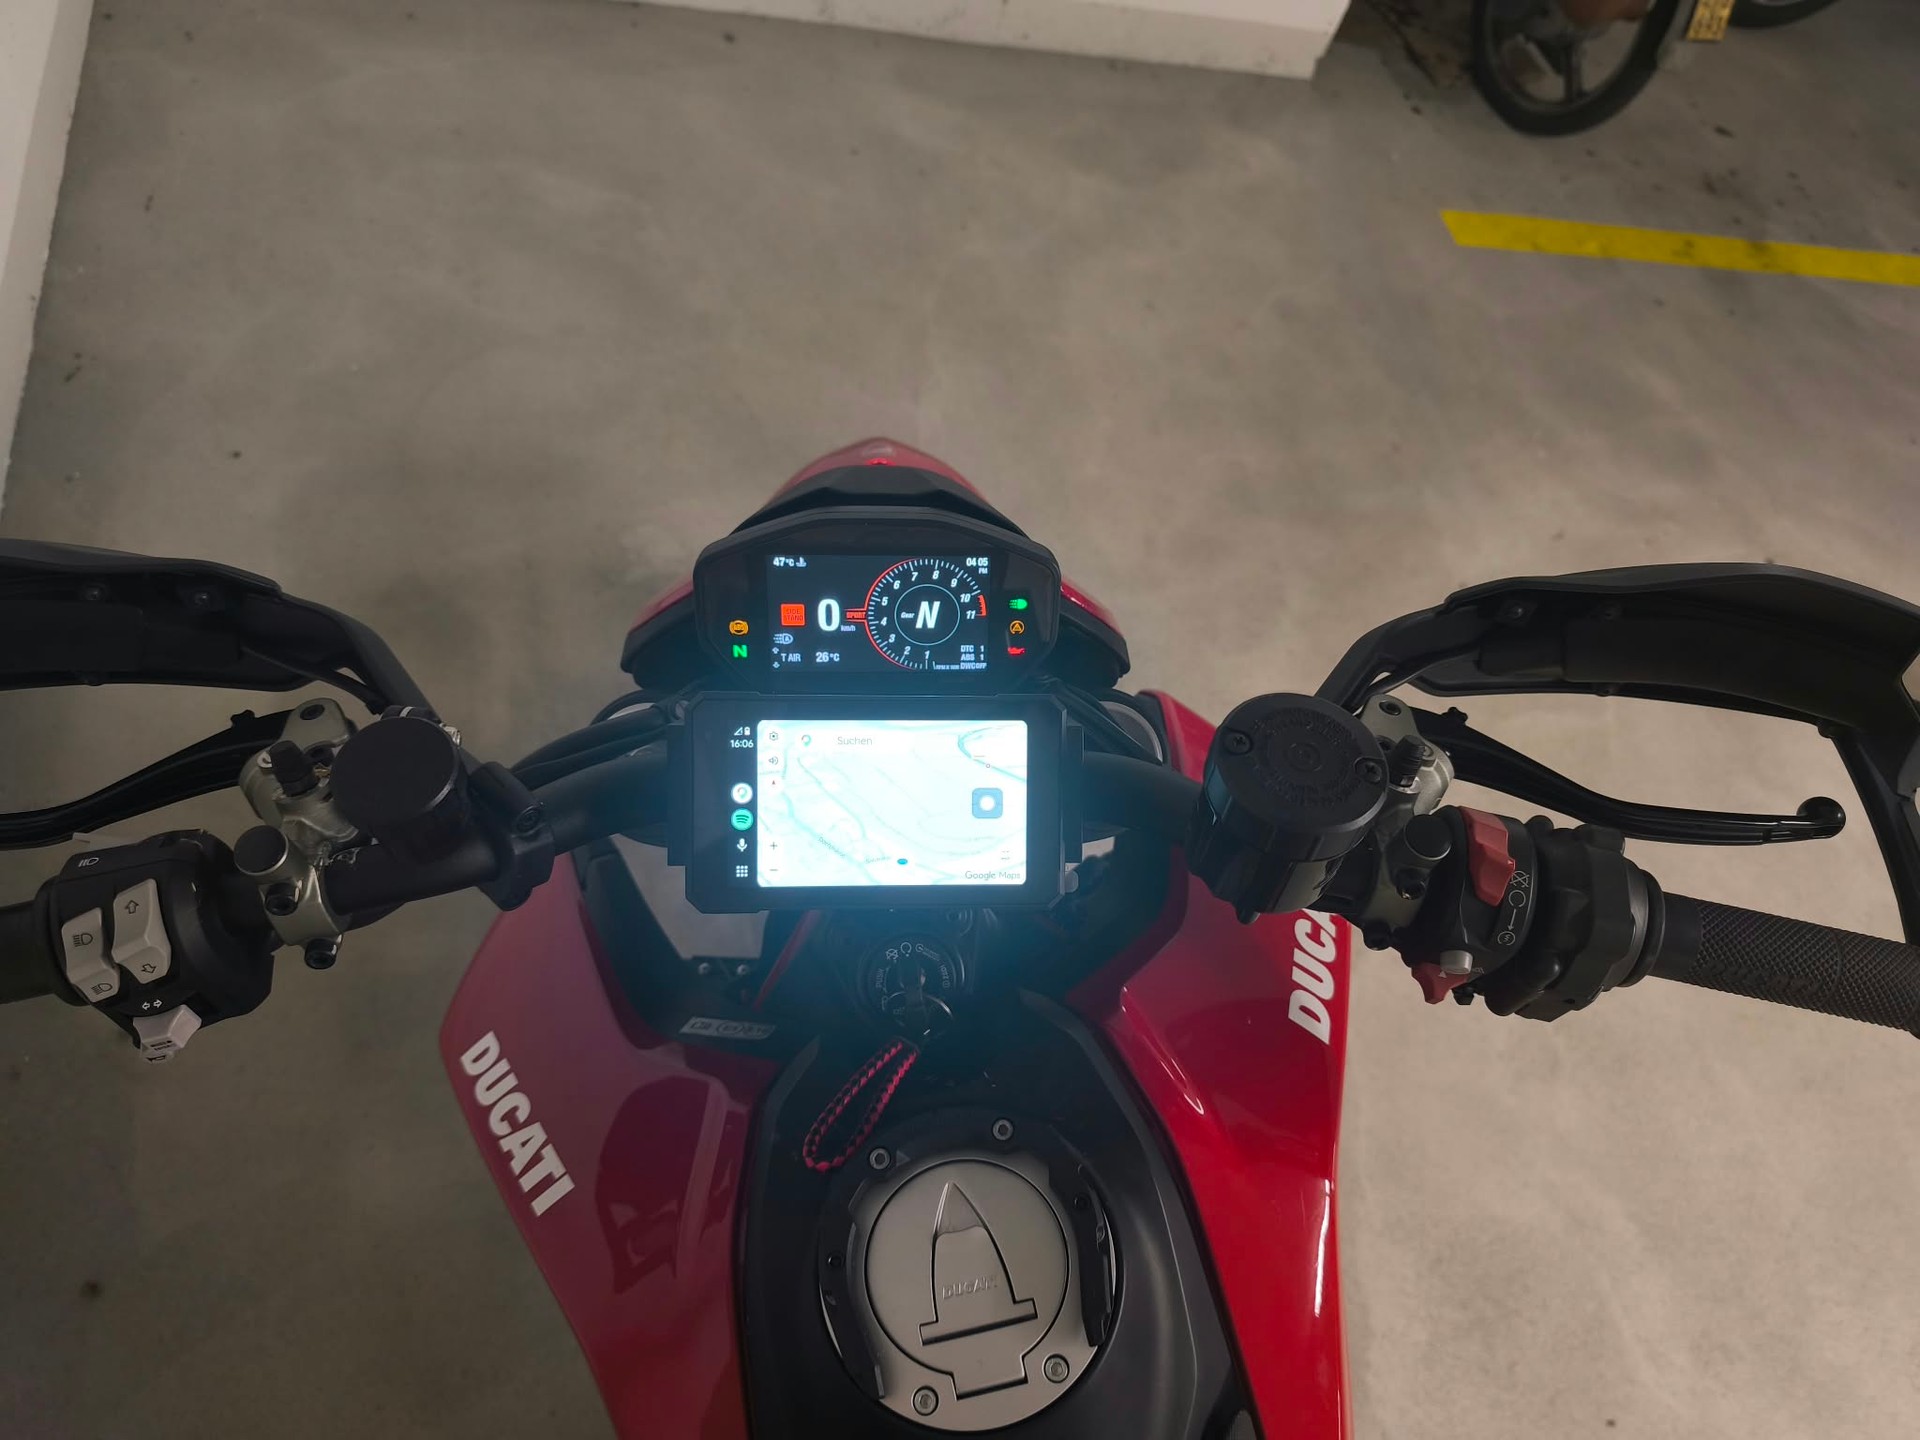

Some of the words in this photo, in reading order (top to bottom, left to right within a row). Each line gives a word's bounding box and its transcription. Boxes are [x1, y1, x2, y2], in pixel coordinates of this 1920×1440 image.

[911, 572, 919, 581] 7
[932, 570, 940, 580] 8
[893, 580, 901, 590] 6
[950, 578, 958, 588] 9
[881, 596, 889, 606] 5
[960, 593, 972, 603] 10
[817, 598, 840, 631] 0
[846, 611, 866, 619] SPORT
[915, 601, 941, 629] N
[966, 610, 976, 619] 11
[880, 617, 888, 626] 4
[889, 634, 896, 643] 3
[733, 645, 748, 658] N
[904, 646, 911, 655] 2
[924, 651, 930, 660] 1
[781, 653, 788, 662] T
[788, 653, 801, 662] AIR
[960, 662, 976, 670] DWC
[730, 739, 754, 748] 16:06
[837, 736, 873, 746] Suchen
[964, 871, 996, 881] Google
[998, 871, 1021, 880] Maps
[460, 1030, 576, 1217] DUCATI
